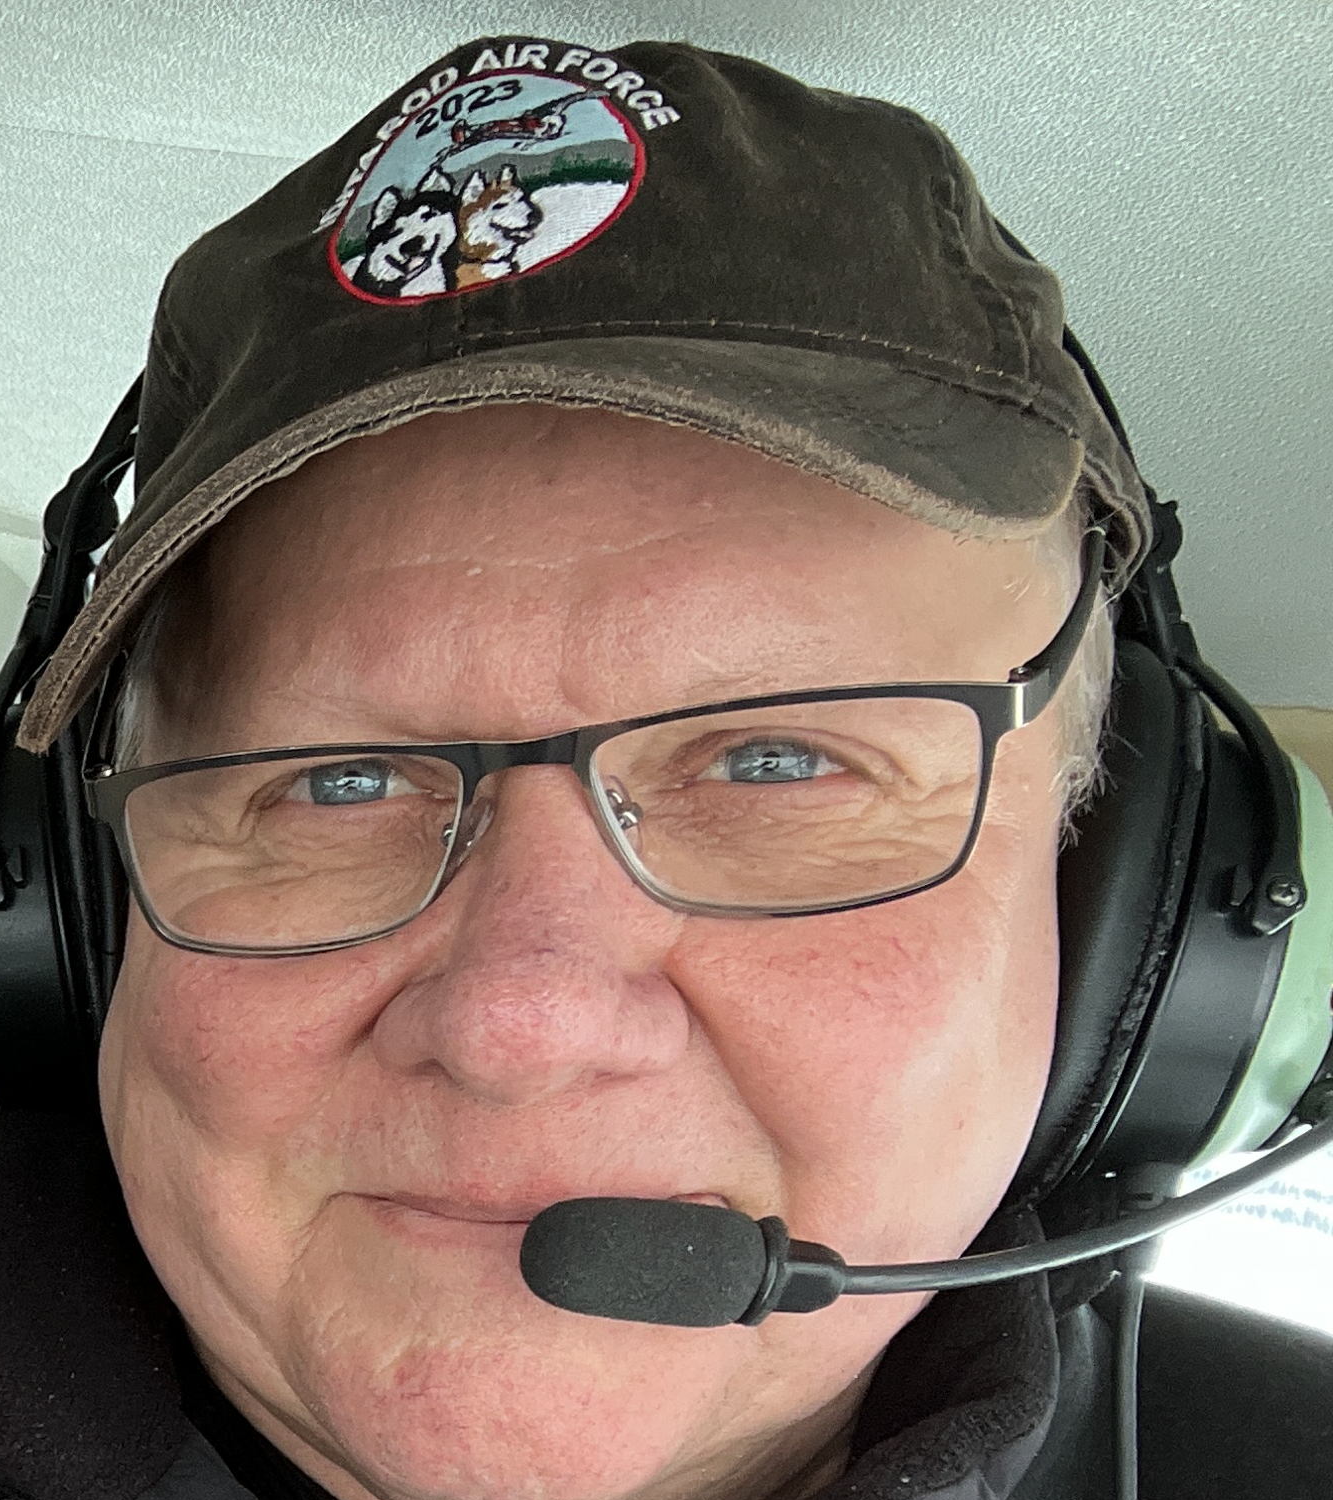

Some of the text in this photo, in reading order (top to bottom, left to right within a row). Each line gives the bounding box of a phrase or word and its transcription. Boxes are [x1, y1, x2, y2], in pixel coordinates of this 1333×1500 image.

[414, 79, 523, 140] 2023
[467, 43, 550, 77] AIR
[555, 48, 681, 131] FORCE
